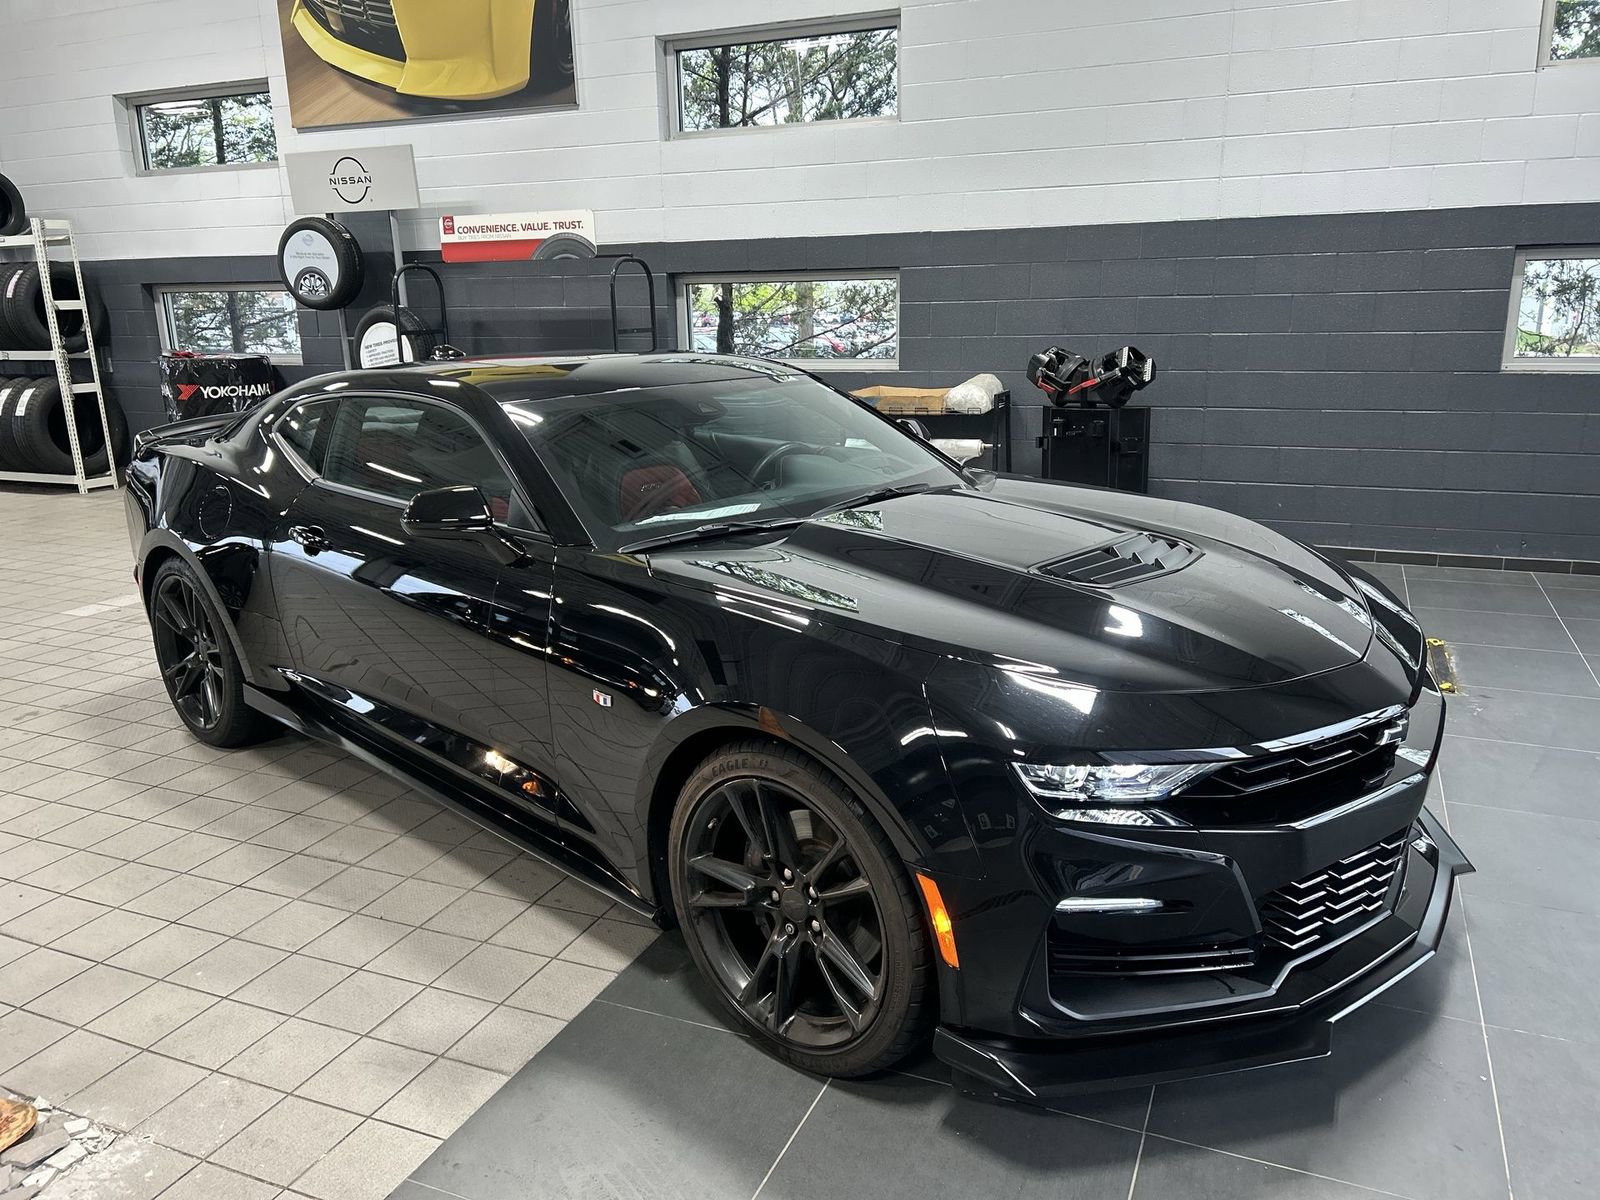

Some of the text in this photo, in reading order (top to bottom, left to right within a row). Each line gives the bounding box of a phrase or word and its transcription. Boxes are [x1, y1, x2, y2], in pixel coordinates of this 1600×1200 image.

[329, 176, 372, 185] NISSAN
[457, 220, 584, 235] CONVENIENCE. VALUE. TRUST.
[711, 758, 749, 778] EAGLE
